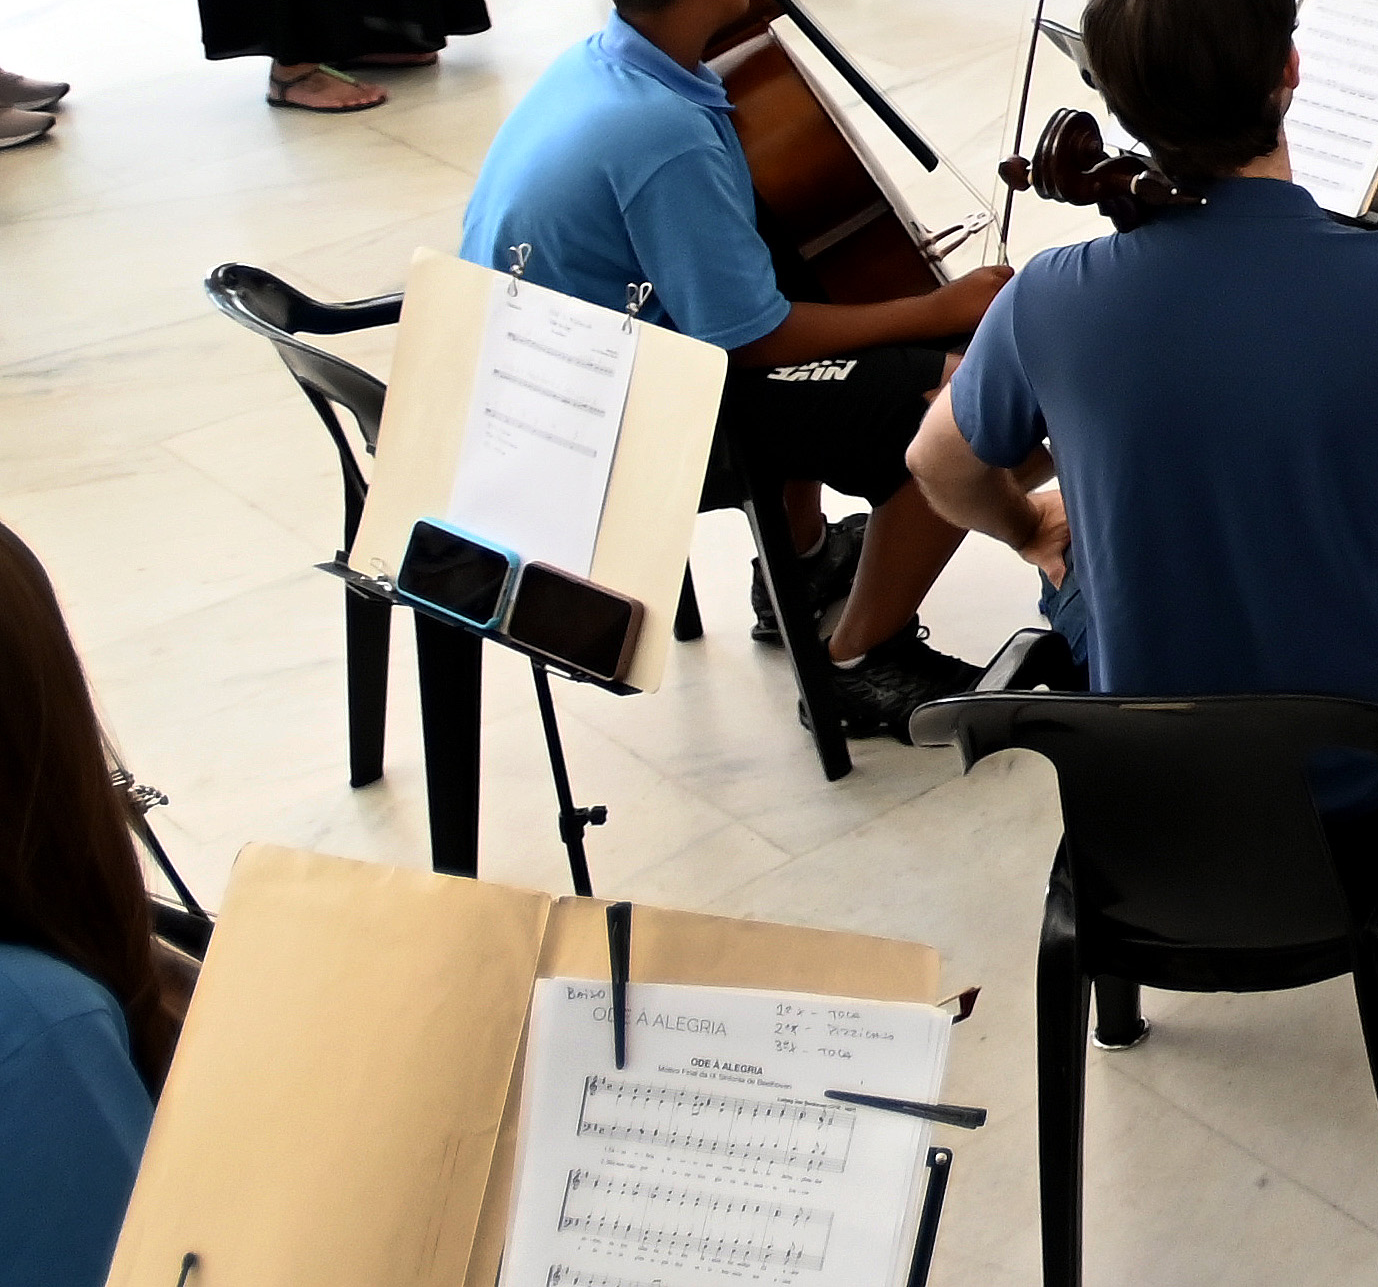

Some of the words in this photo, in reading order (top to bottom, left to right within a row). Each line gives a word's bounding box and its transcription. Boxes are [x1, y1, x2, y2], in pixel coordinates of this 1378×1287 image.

[653, 1013, 727, 1036] ALEGRIA
[690, 1057, 710, 1068] ODE
[722, 1061, 763, 1075] ALEGRIA
